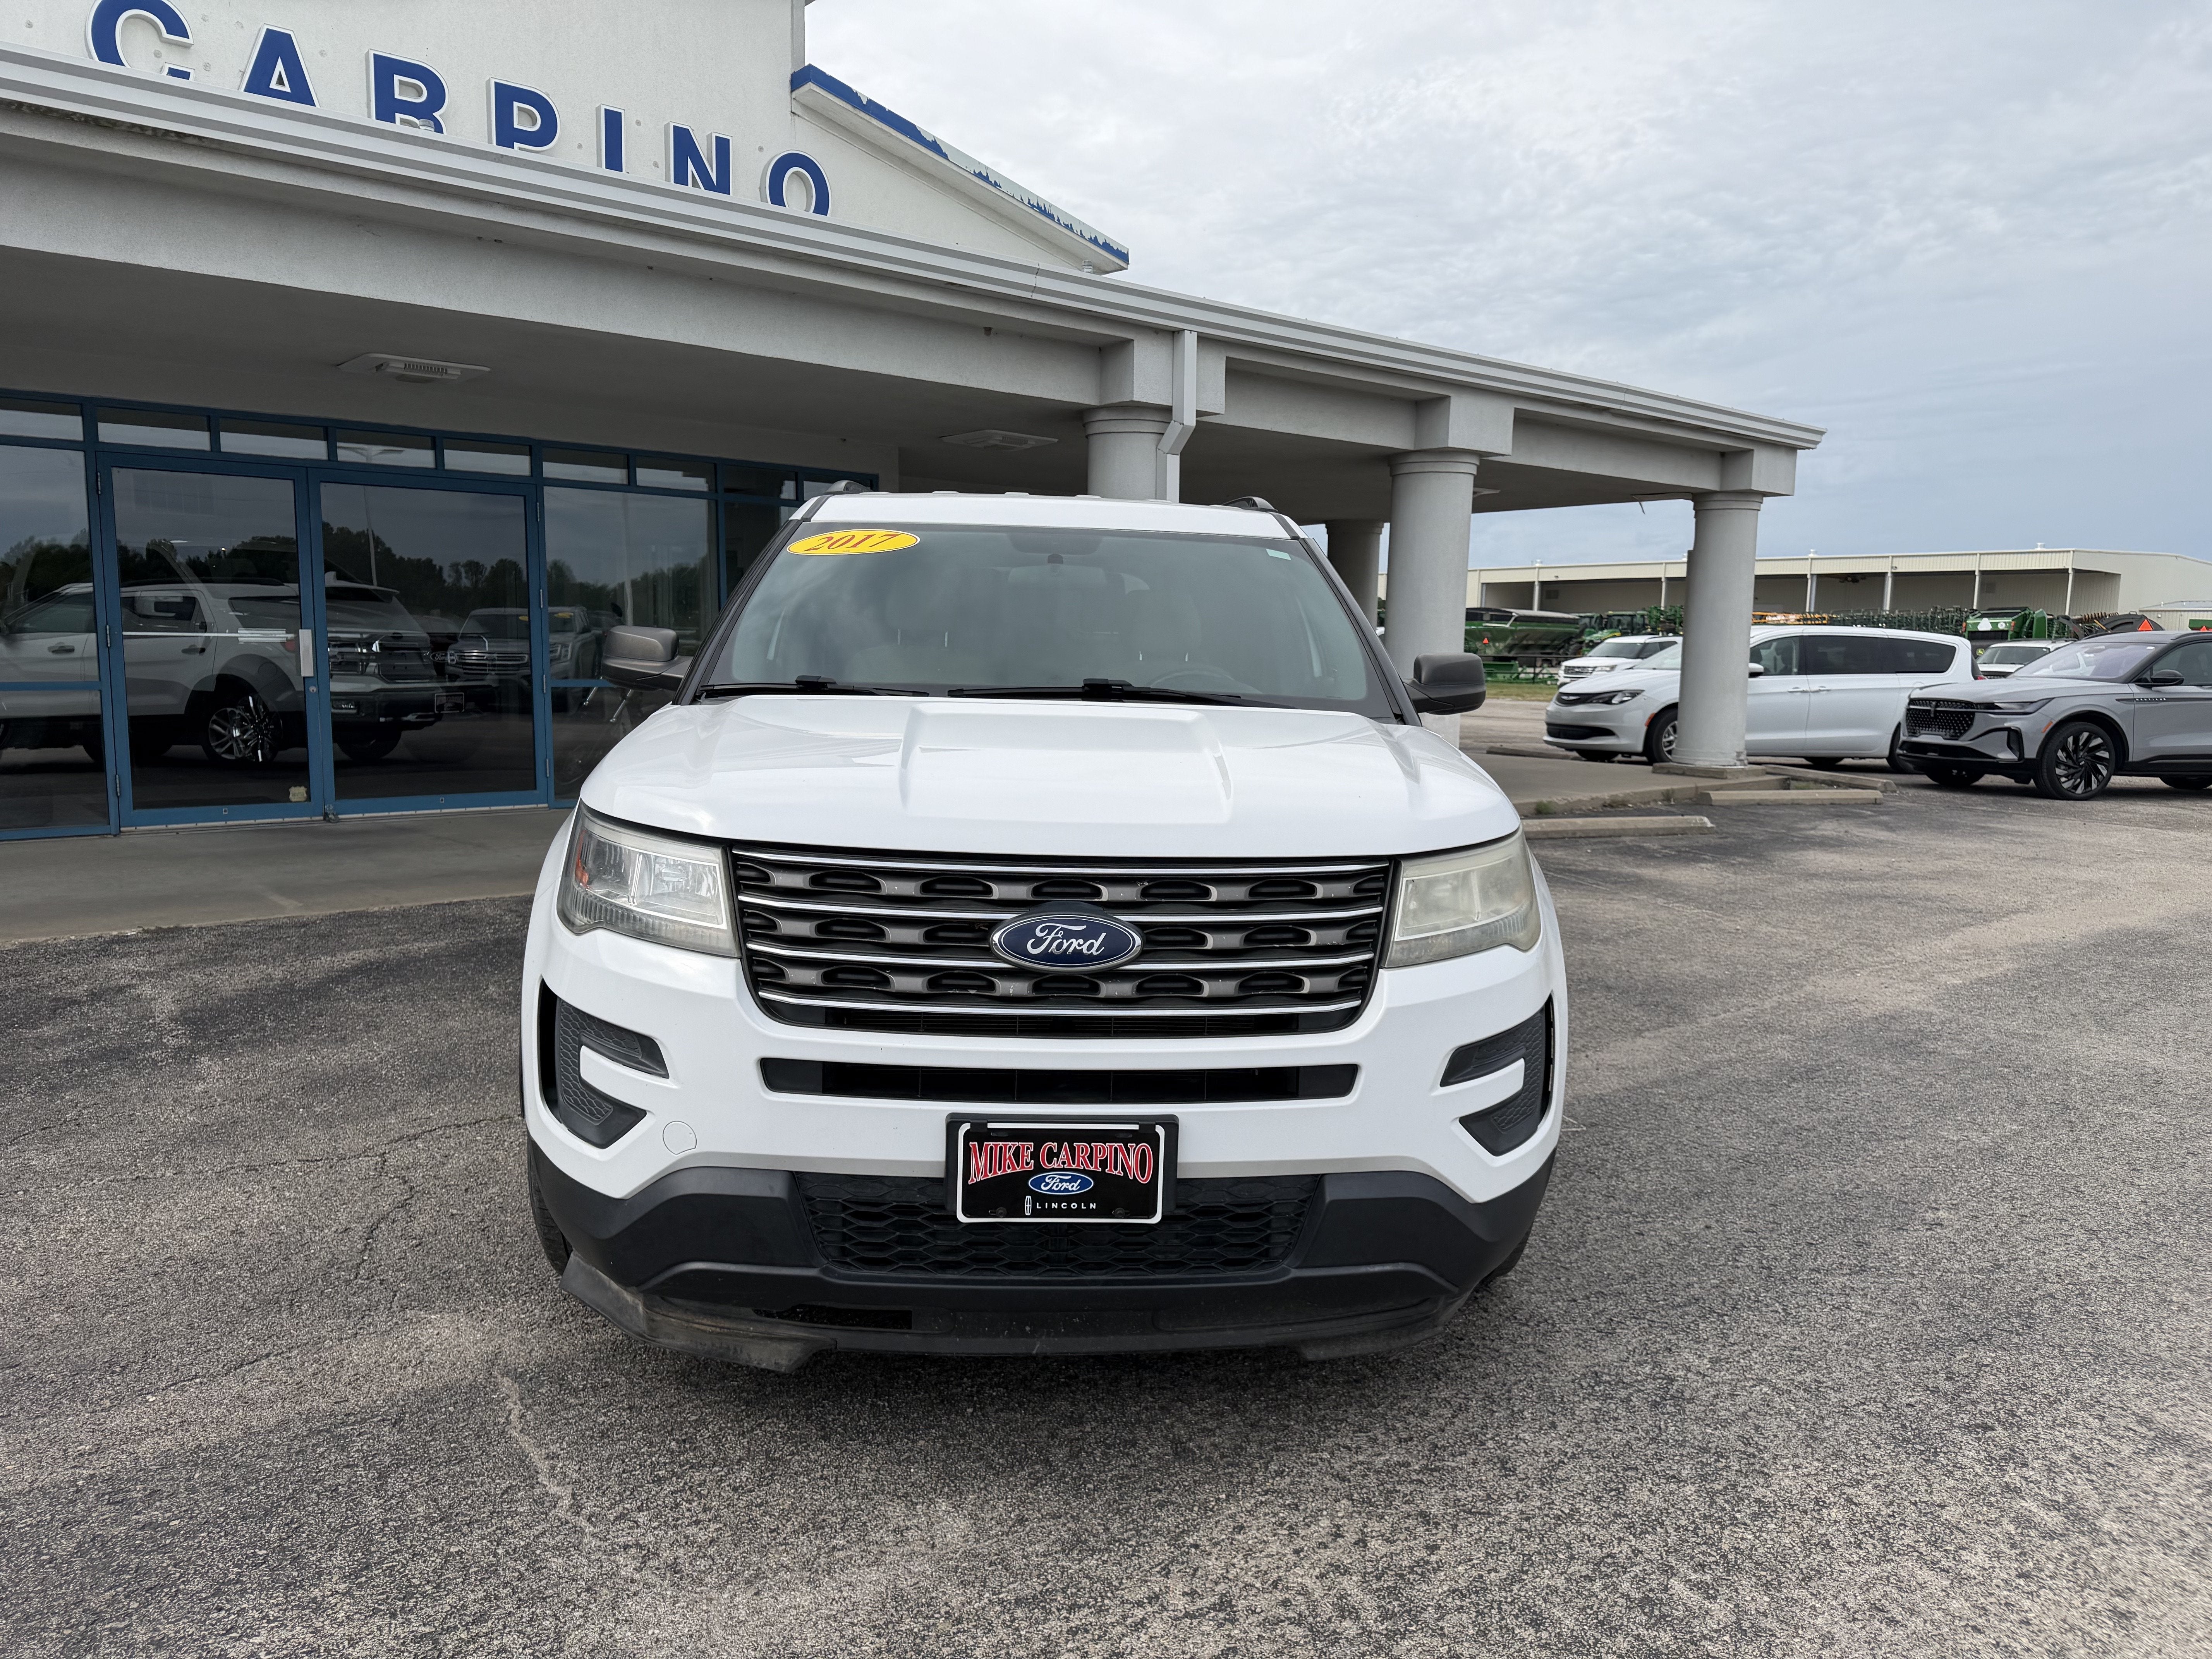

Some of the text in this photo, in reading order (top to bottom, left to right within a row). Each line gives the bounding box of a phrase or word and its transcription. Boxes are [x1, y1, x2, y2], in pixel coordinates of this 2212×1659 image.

[87, 0, 831, 216] CARPINO
[804, 534, 901, 551] 2017
[1027, 923, 1106, 955] Ford
[968, 1142, 1153, 1184] MIKE CARPINO
[1041, 1175, 1081, 1191] Ford
